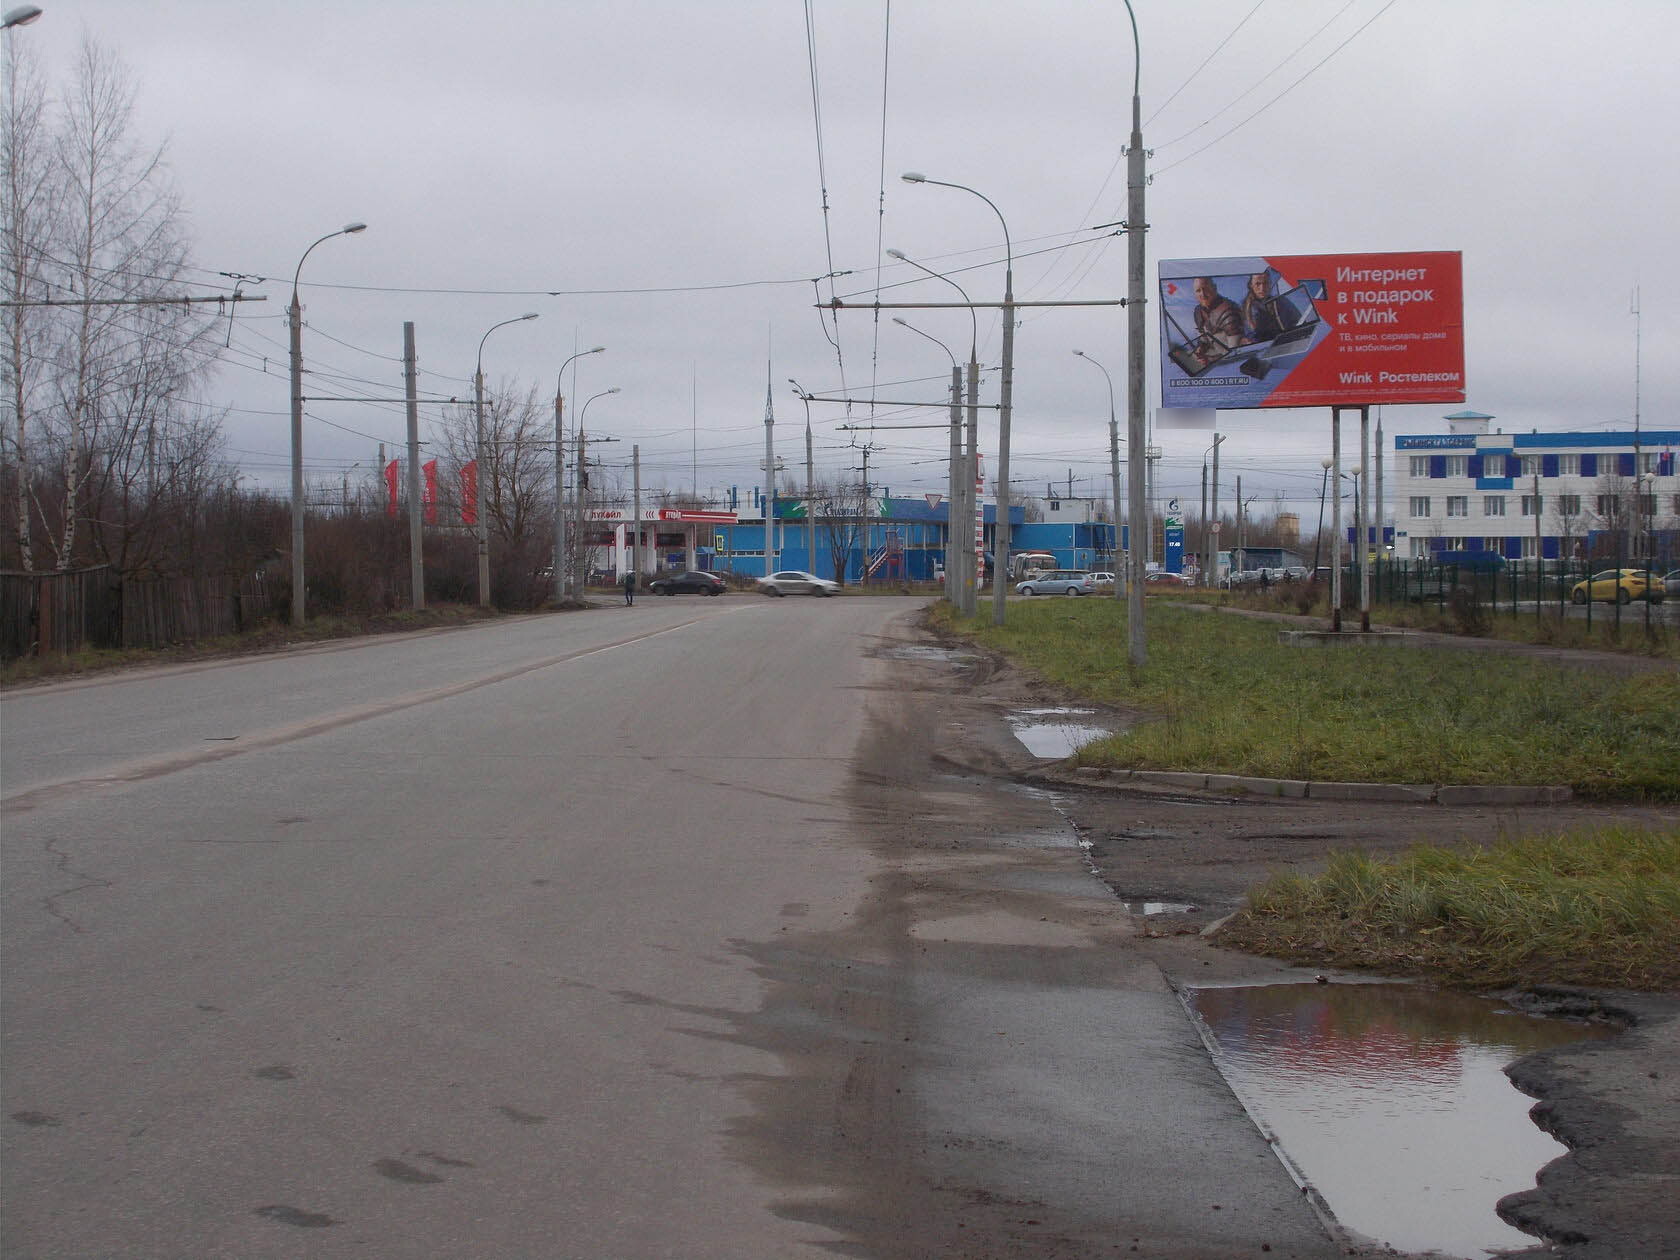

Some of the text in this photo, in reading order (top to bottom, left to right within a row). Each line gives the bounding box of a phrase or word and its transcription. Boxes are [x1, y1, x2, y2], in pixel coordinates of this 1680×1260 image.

[1336, 266, 1427, 285] Интернет
[1337, 289, 1434, 305] в подарок
[1337, 308, 1399, 325] к Wink
[1354, 343, 1408, 352] мобильном
[1339, 370, 1460, 384] Wink Ростелеком
